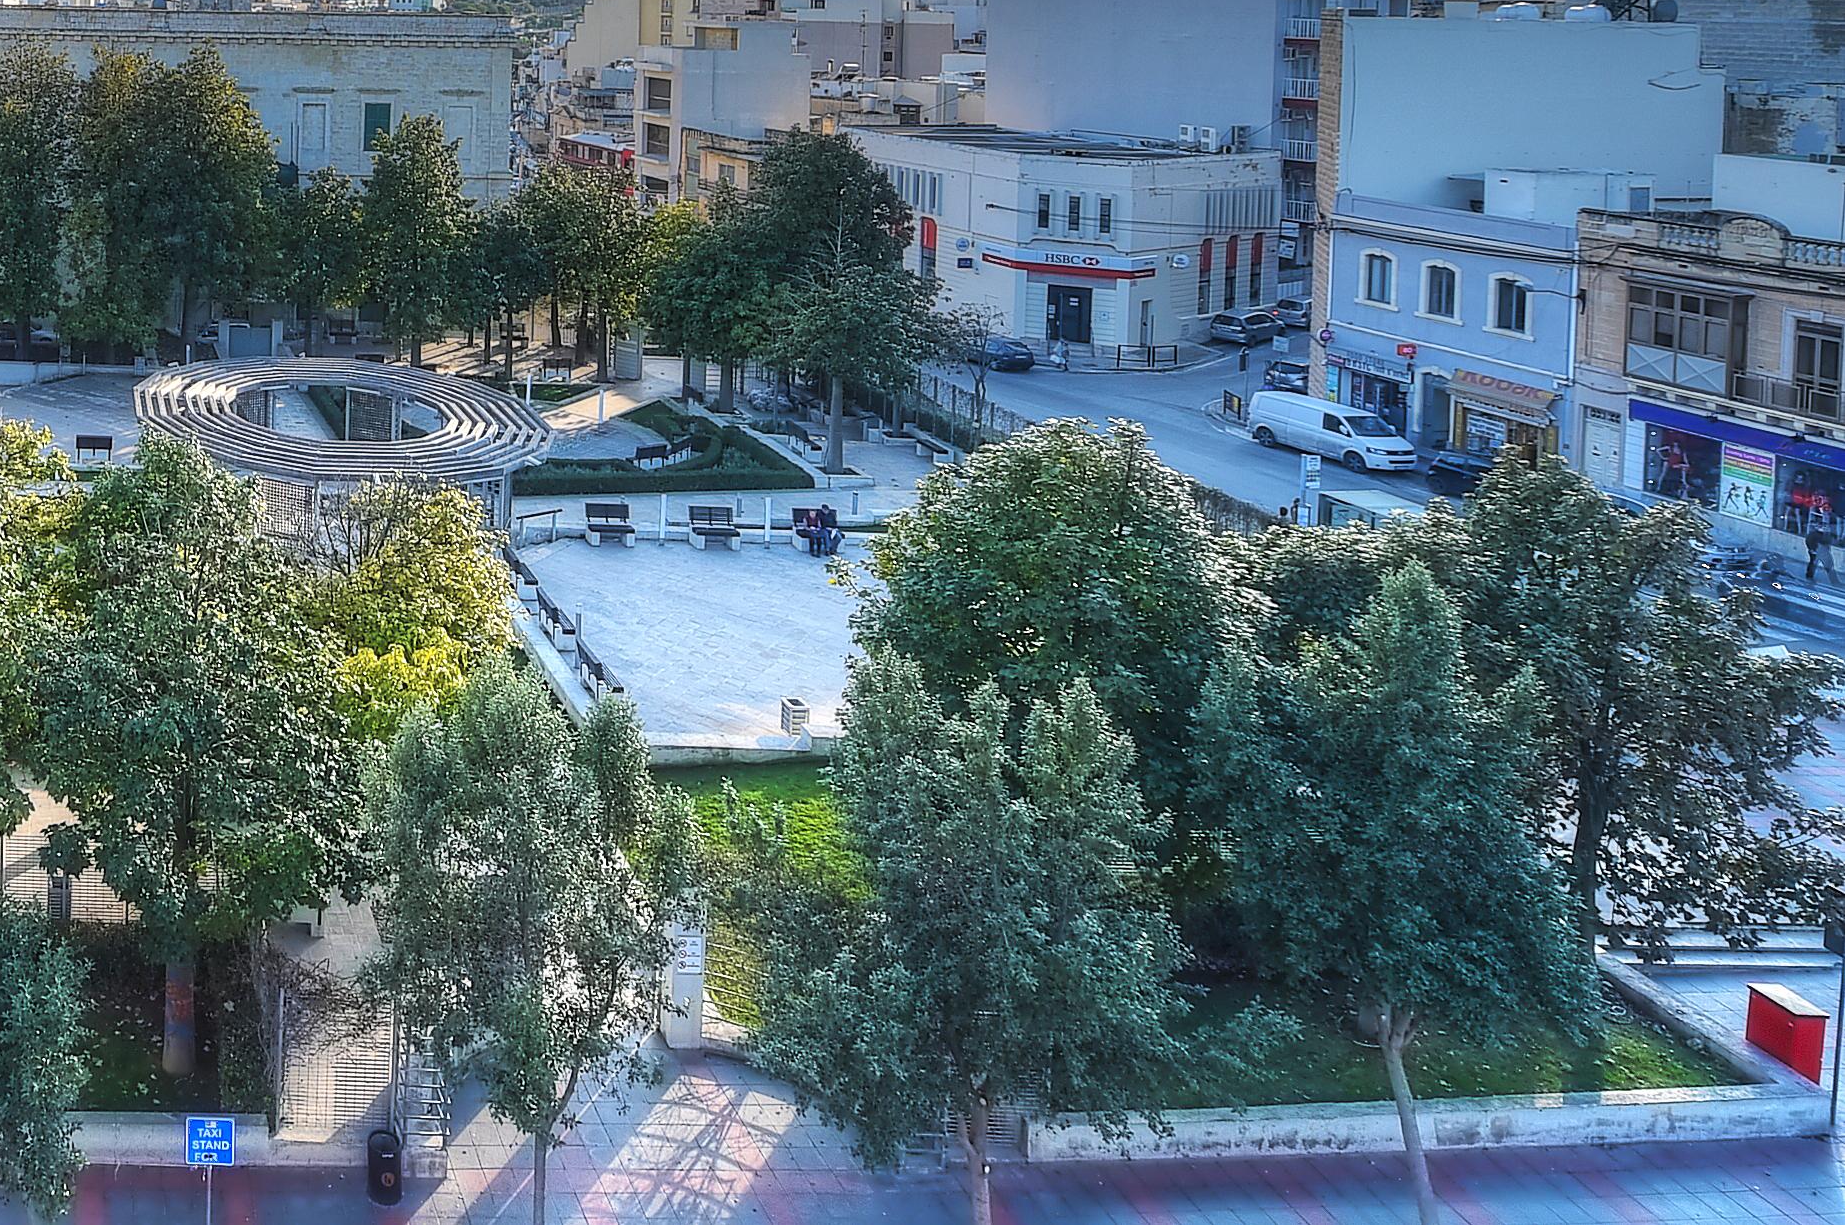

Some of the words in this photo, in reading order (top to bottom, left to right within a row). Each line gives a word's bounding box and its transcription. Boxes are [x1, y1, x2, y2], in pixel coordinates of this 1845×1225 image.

[1045, 253, 1081, 265] HSBC
[197, 1128, 222, 1138] TAXI
[192, 1140, 230, 1151] STAND
